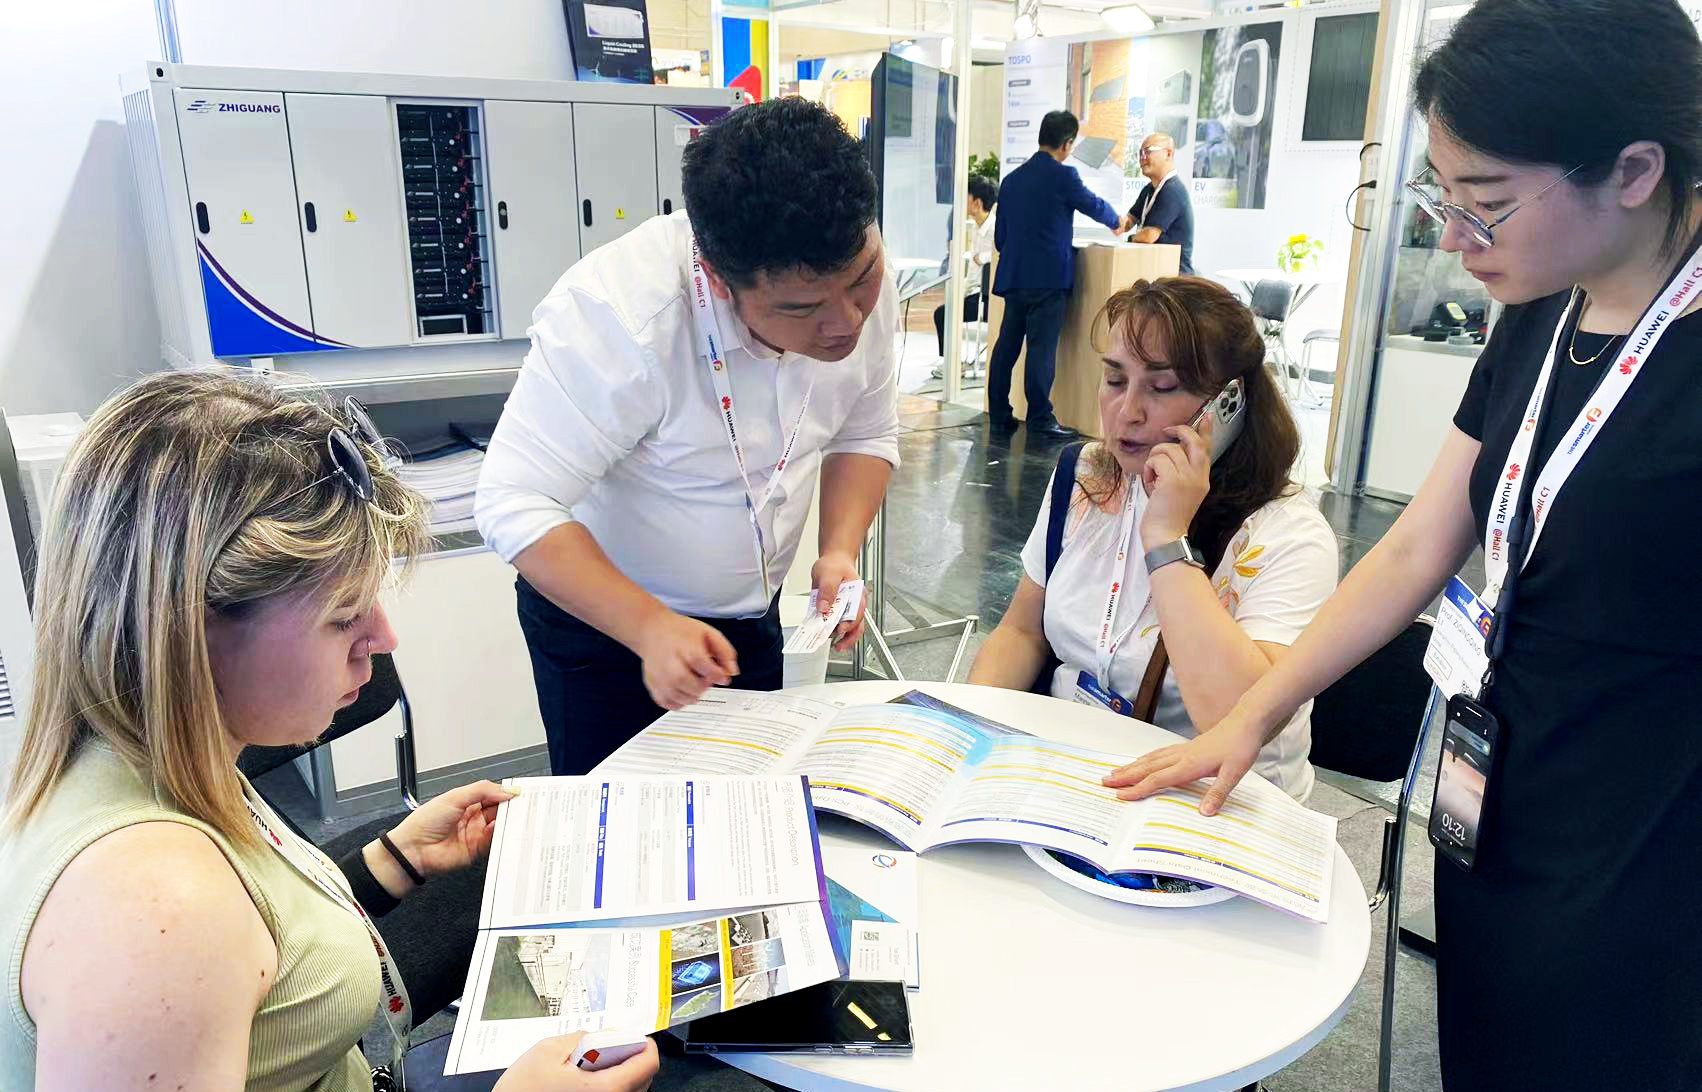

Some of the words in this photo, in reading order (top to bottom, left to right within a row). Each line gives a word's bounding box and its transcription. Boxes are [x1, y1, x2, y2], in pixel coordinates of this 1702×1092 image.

[1008, 55, 1032, 65] TOSPO
[218, 103, 281, 114] ZHIGUANG
[1194, 181, 1206, 191] EV
[1634, 310, 1670, 355] HUAWEI
[1669, 279, 1695, 307] @Hall
[1496, 482, 1513, 524] HUAWEI
[1540, 486, 1551, 498] C1
[1492, 528, 1503, 552] @Hall
[1491, 551, 1500, 561] C1
[1106, 594, 1116, 621] HUAWEI
[785, 806, 796, 829] Product
[1442, 813, 1466, 842] 12:10
[787, 829, 799, 866] Description
[380, 961, 397, 997] HUAWEI
[627, 960, 640, 992] Successful
[626, 991, 638, 1008] Case
